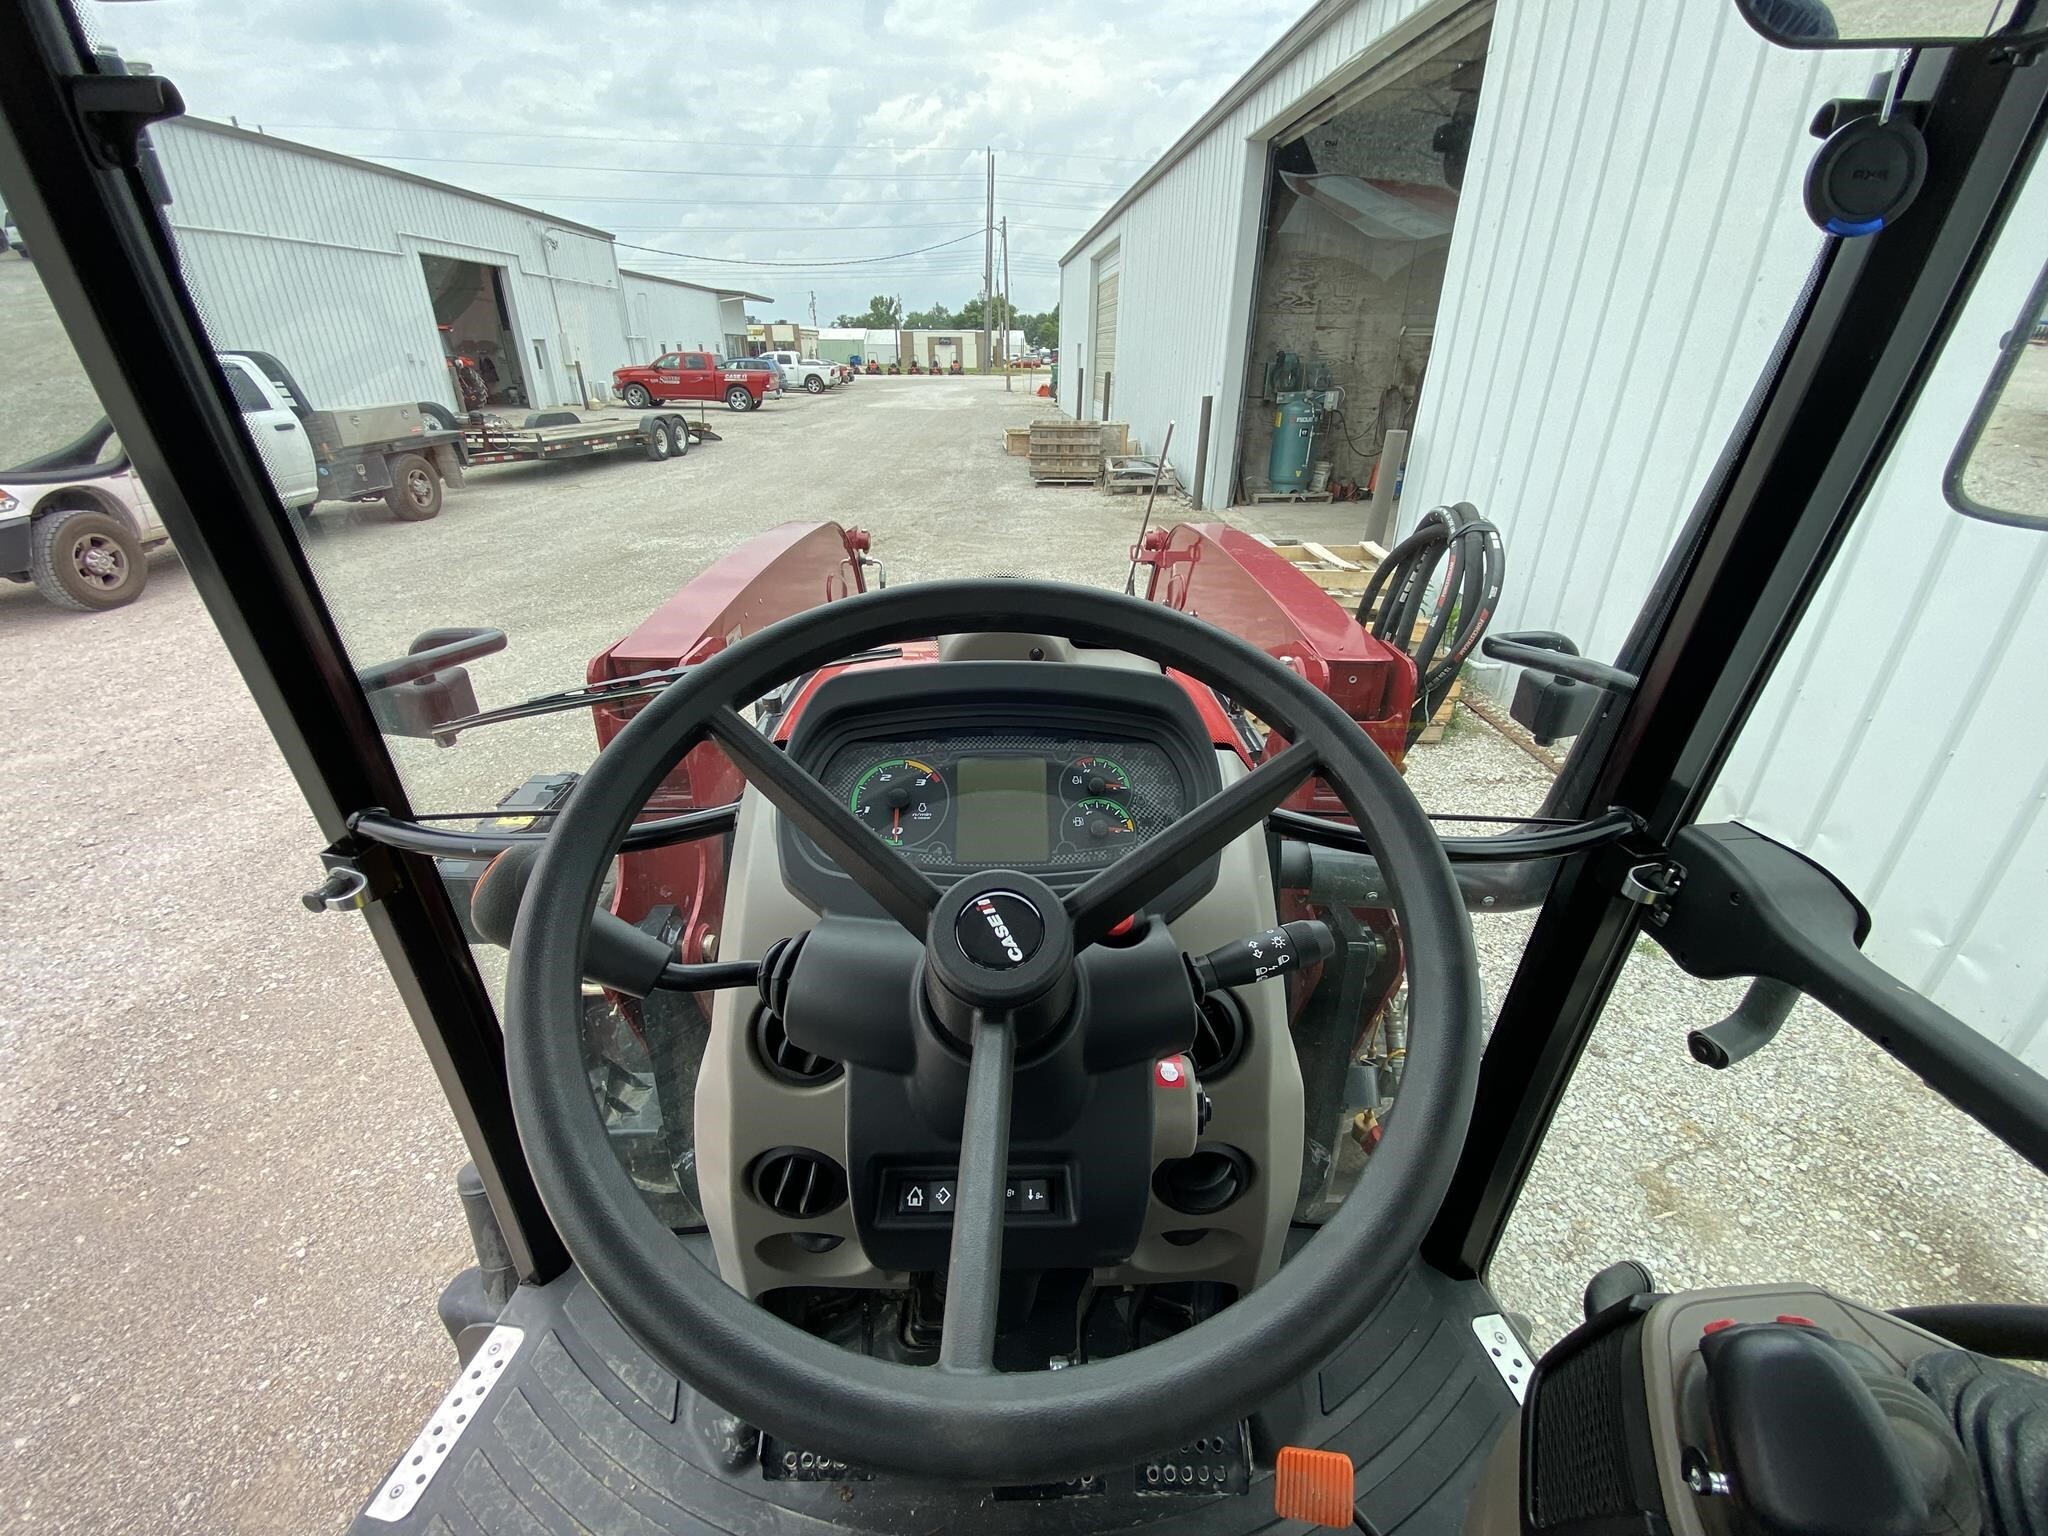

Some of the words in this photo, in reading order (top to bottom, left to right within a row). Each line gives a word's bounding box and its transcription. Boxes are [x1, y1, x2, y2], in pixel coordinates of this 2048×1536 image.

[1459, 617, 1484, 656] FORCESTREAM
[879, 774, 892, 782] 2
[915, 778, 927, 787] 3
[864, 806, 871, 814] 1
[986, 913, 1024, 962] CASE
